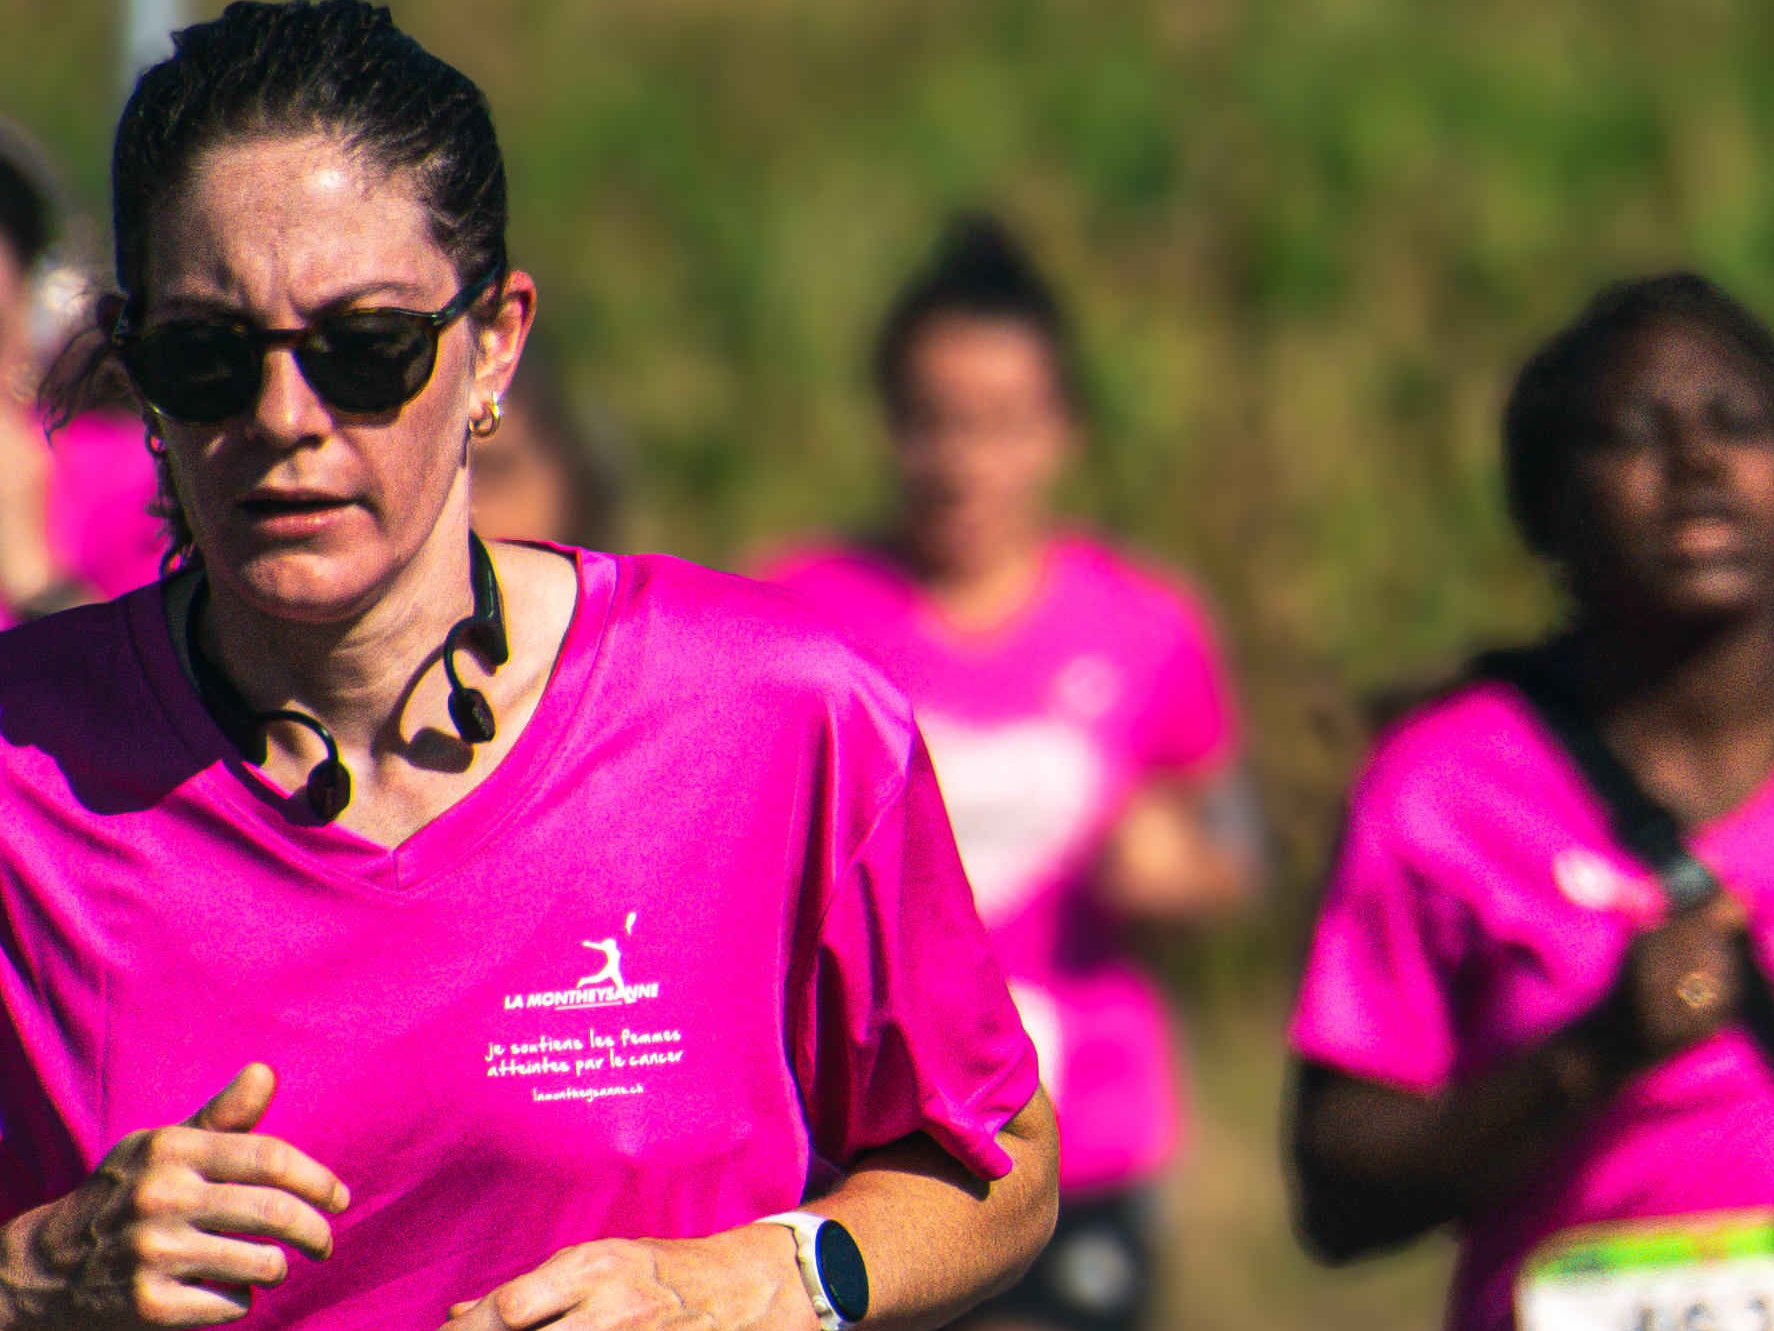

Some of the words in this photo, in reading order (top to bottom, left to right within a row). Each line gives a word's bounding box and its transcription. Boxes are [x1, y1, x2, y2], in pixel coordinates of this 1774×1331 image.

[504, 995, 524, 1010] LA
[526, 982, 659, 1008] MONTHEYSANNE
[485, 1042, 504, 1061] je
[511, 1035, 583, 1056] soutiens
[589, 1028, 614, 1049] les
[621, 1028, 682, 1047] femmes
[487, 1056, 570, 1077] atteintes
[576, 1055, 604, 1076] par
[609, 1048, 626, 1068] le
[630, 1049, 683, 1066] cancer
